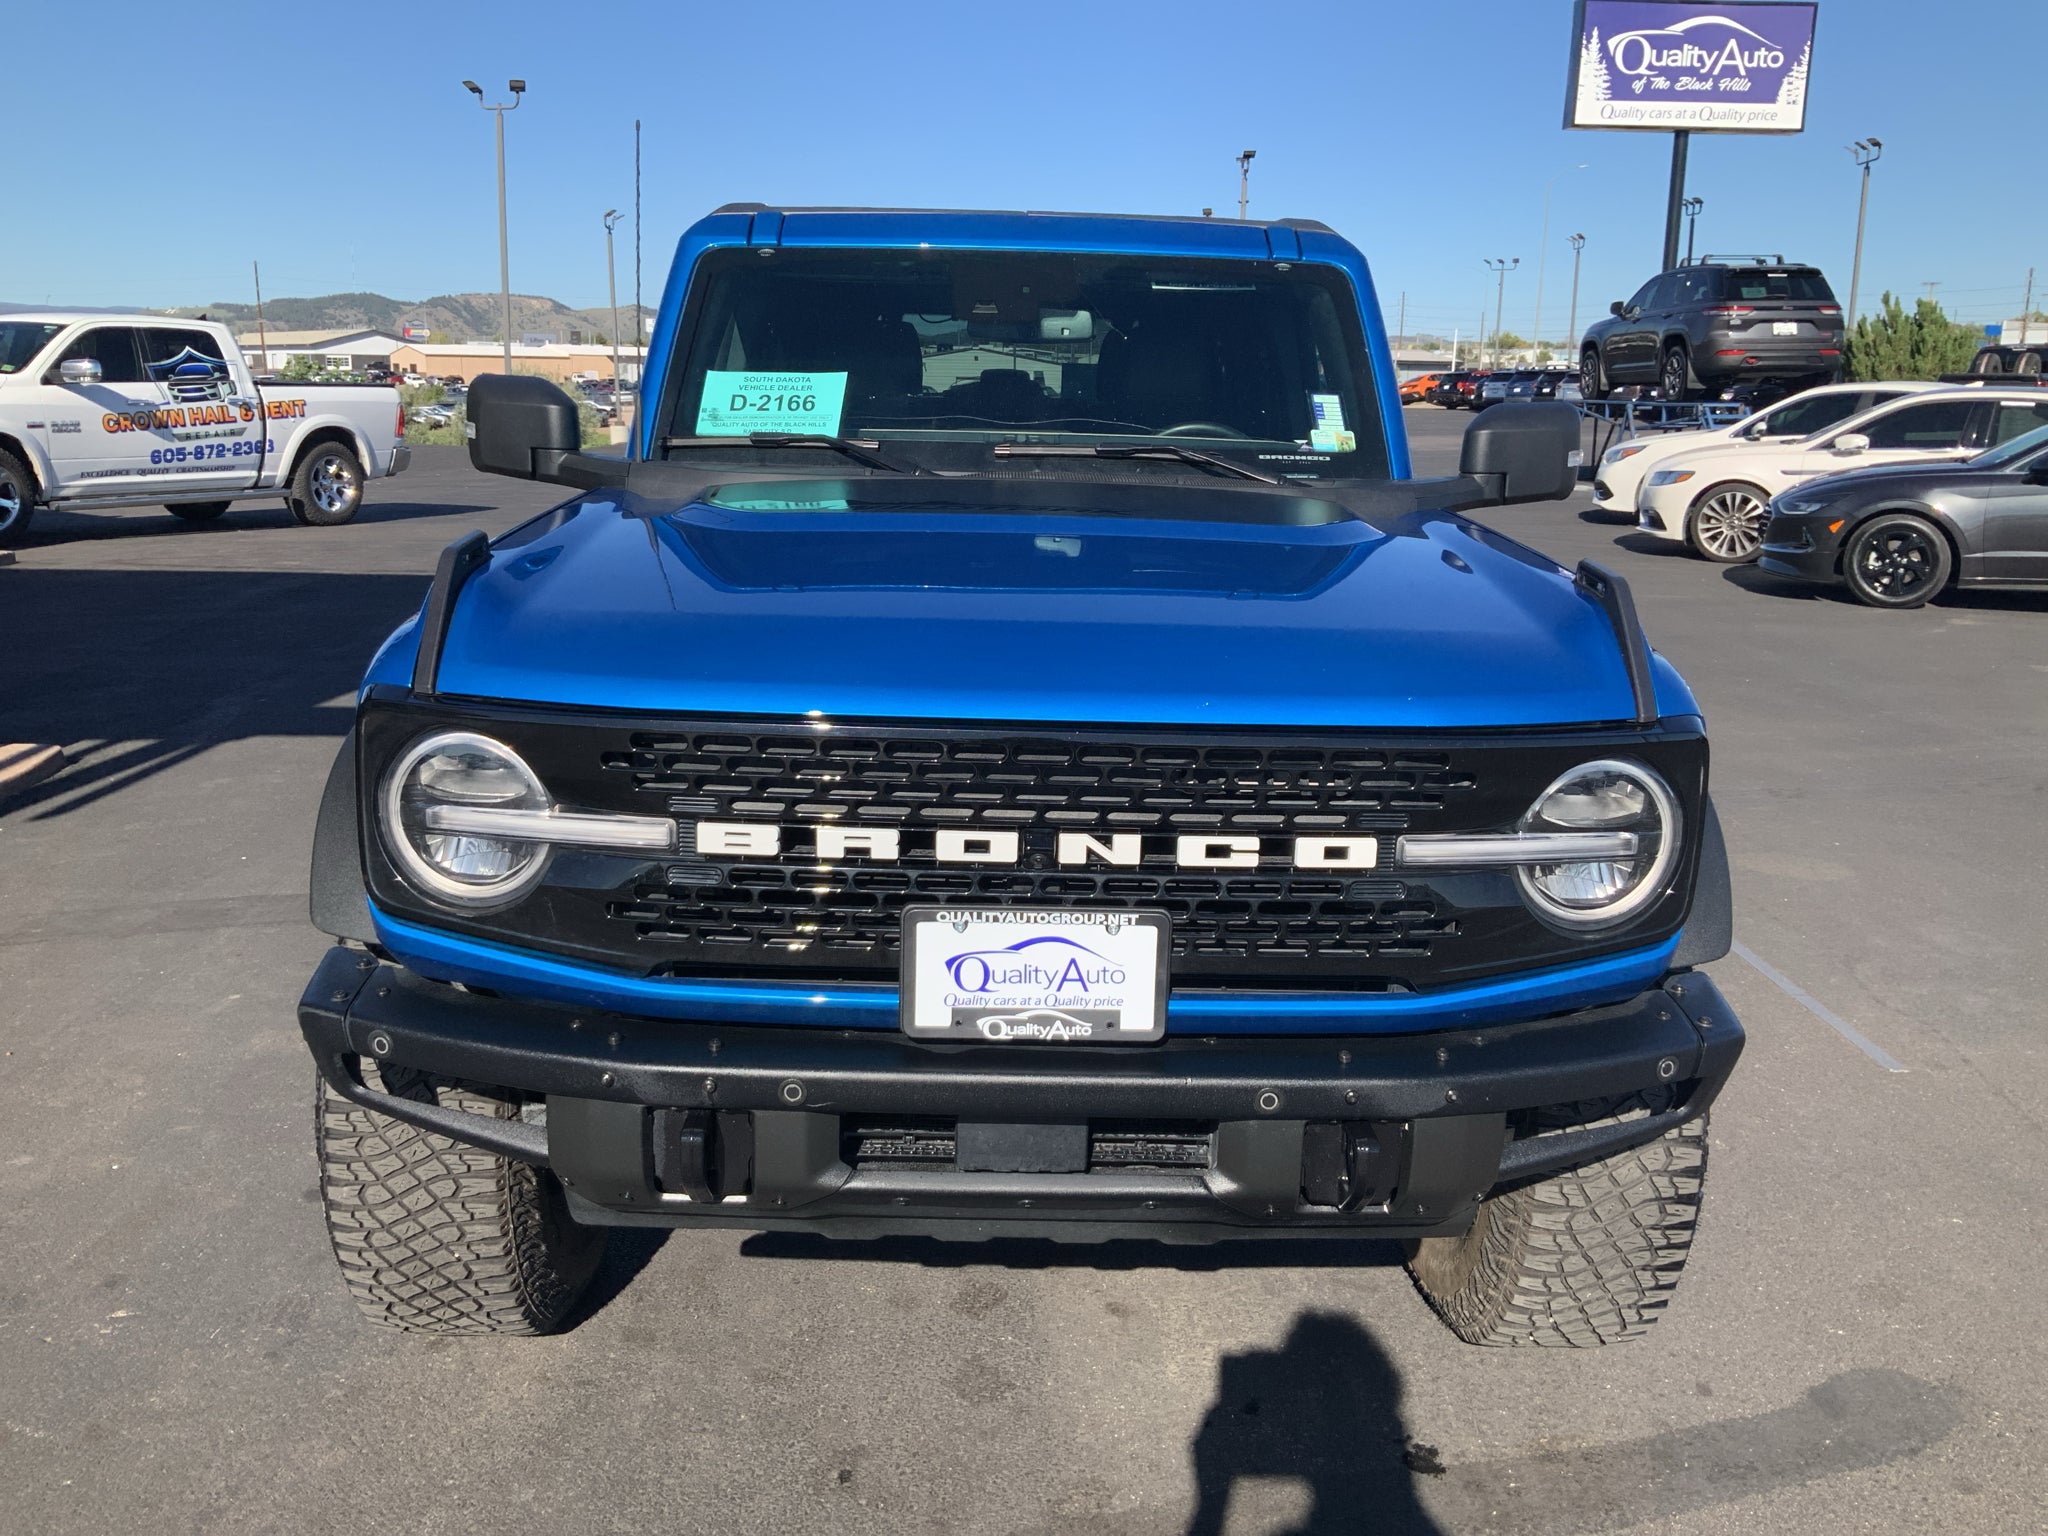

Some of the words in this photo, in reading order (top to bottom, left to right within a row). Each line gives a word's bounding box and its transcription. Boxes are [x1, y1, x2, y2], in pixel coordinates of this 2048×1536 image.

[1632, 77, 1647, 92] of
[1650, 77, 1670, 91] The
[1674, 77, 1712, 91] Black
[1719, 77, 1751, 92] Hills
[1600, 104, 1646, 120] Quality
[1649, 109, 1673, 119] cars
[1676, 109, 1688, 119] at
[1690, 111, 1697, 119] a
[1699, 105, 1747, 123] Quality
[1748, 110, 1778, 123] price
[729, 394, 816, 412] D-2166
[102, 407, 188, 432] CROWN
[188, 404, 237, 427] HAIL
[239, 403, 255, 421] &
[185, 428, 237, 440] REPAIR
[80, 468, 131, 479] EXCELLENCE
[137, 467, 170, 476] QUALITY
[176, 464, 236, 474] CRAFTSMANSHIP
[697, 821, 1379, 869] BRONCO
[936, 911, 1139, 927] QUALITYAUTOGROUP.NET
[943, 993, 991, 1008] Quality
[993, 997, 1017, 1006] cars
[1020, 996, 1033, 1006] at
[1035, 998, 1041, 1006] a
[1044, 993, 1091, 1009] Quality
[1093, 997, 1124, 1008] price
